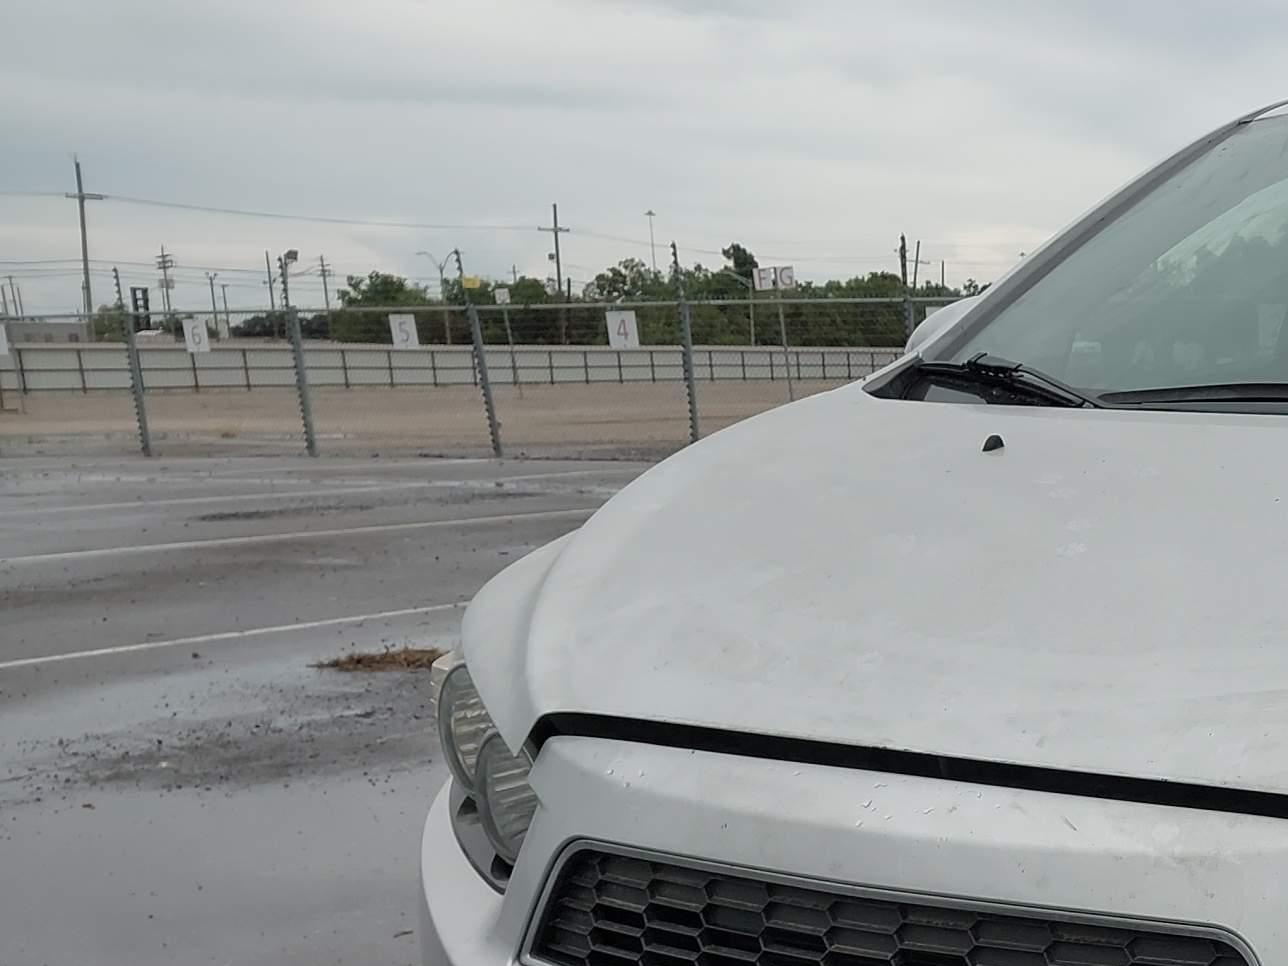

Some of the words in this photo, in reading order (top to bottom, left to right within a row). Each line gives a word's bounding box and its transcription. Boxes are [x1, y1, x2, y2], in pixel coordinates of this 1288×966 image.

[191, 325, 201, 345] 6
[399, 321, 409, 342] 5
[616, 319, 629, 340] 4
